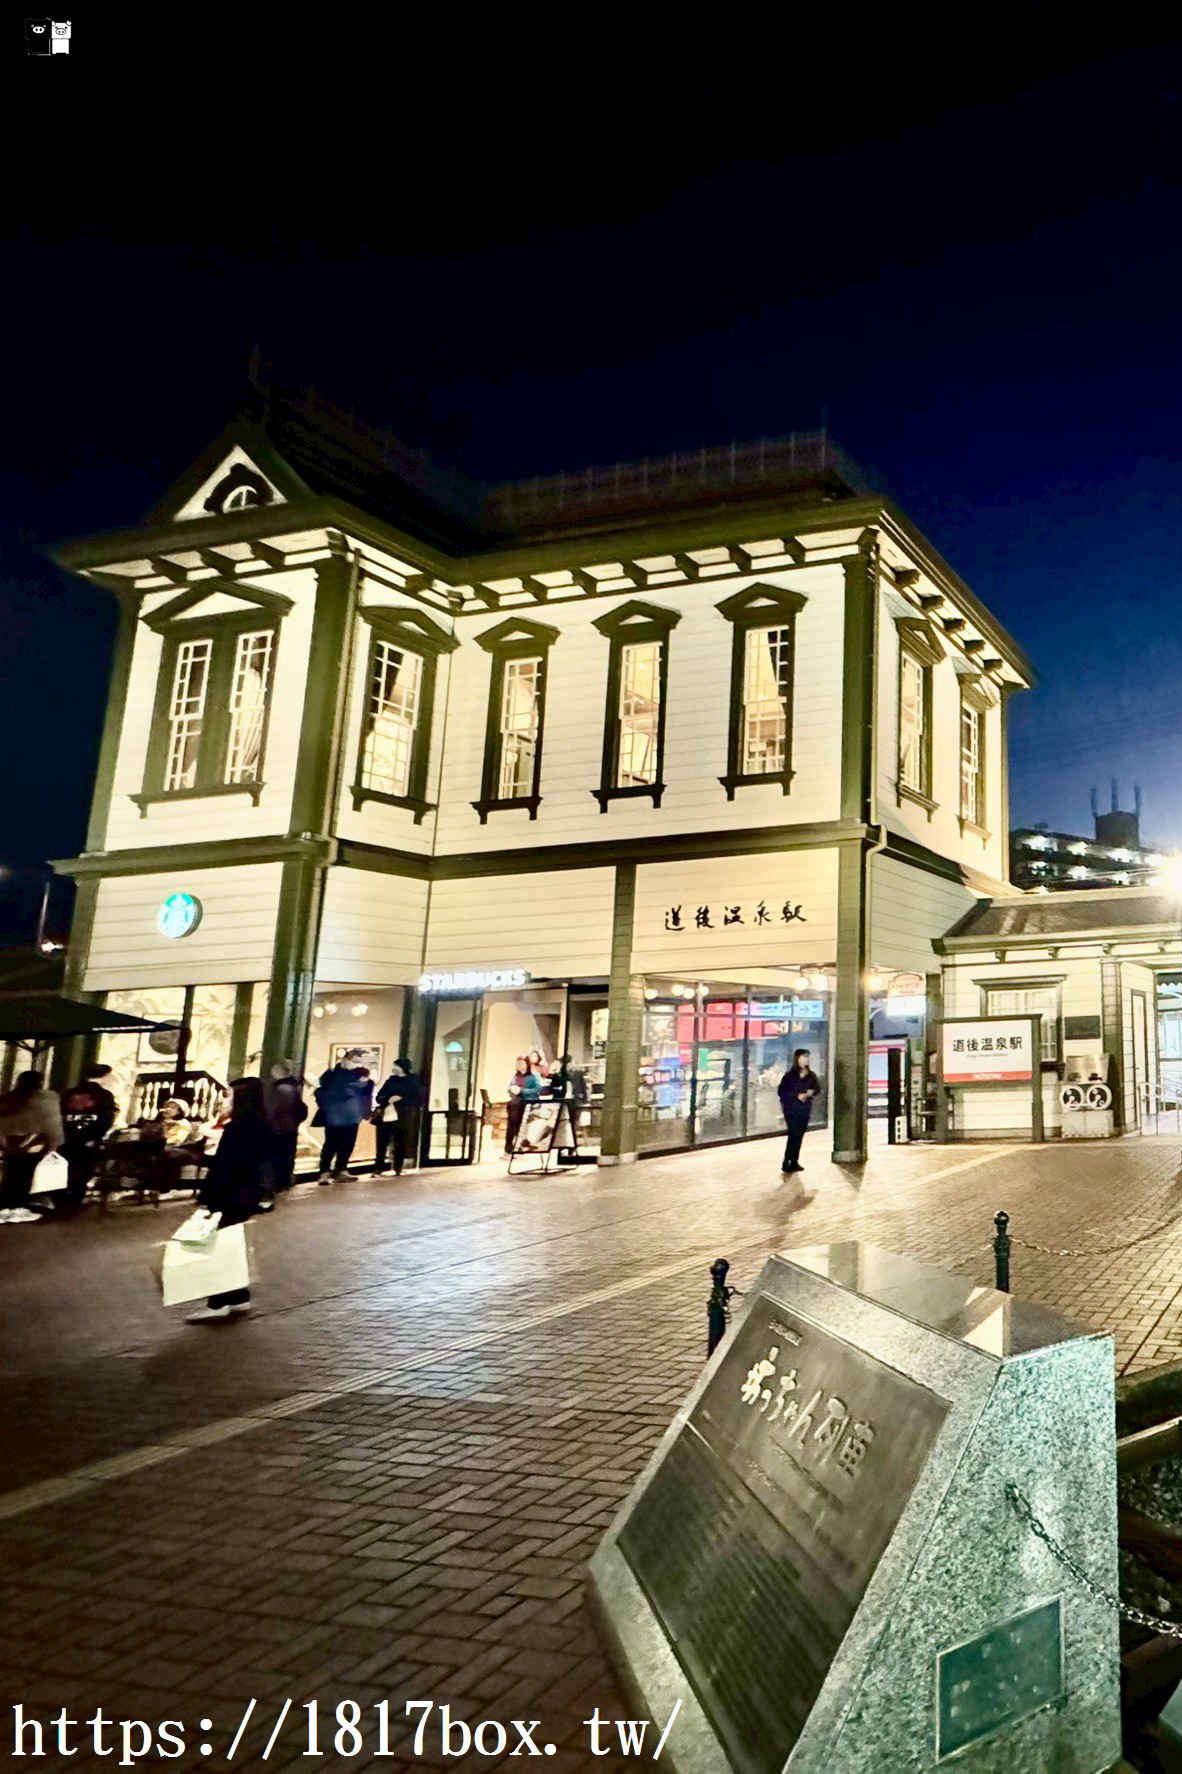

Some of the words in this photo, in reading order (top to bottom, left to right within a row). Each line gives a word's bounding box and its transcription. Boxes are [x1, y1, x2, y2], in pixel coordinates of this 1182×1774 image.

[952, 1035, 1023, 1053] 道後温泉駅
